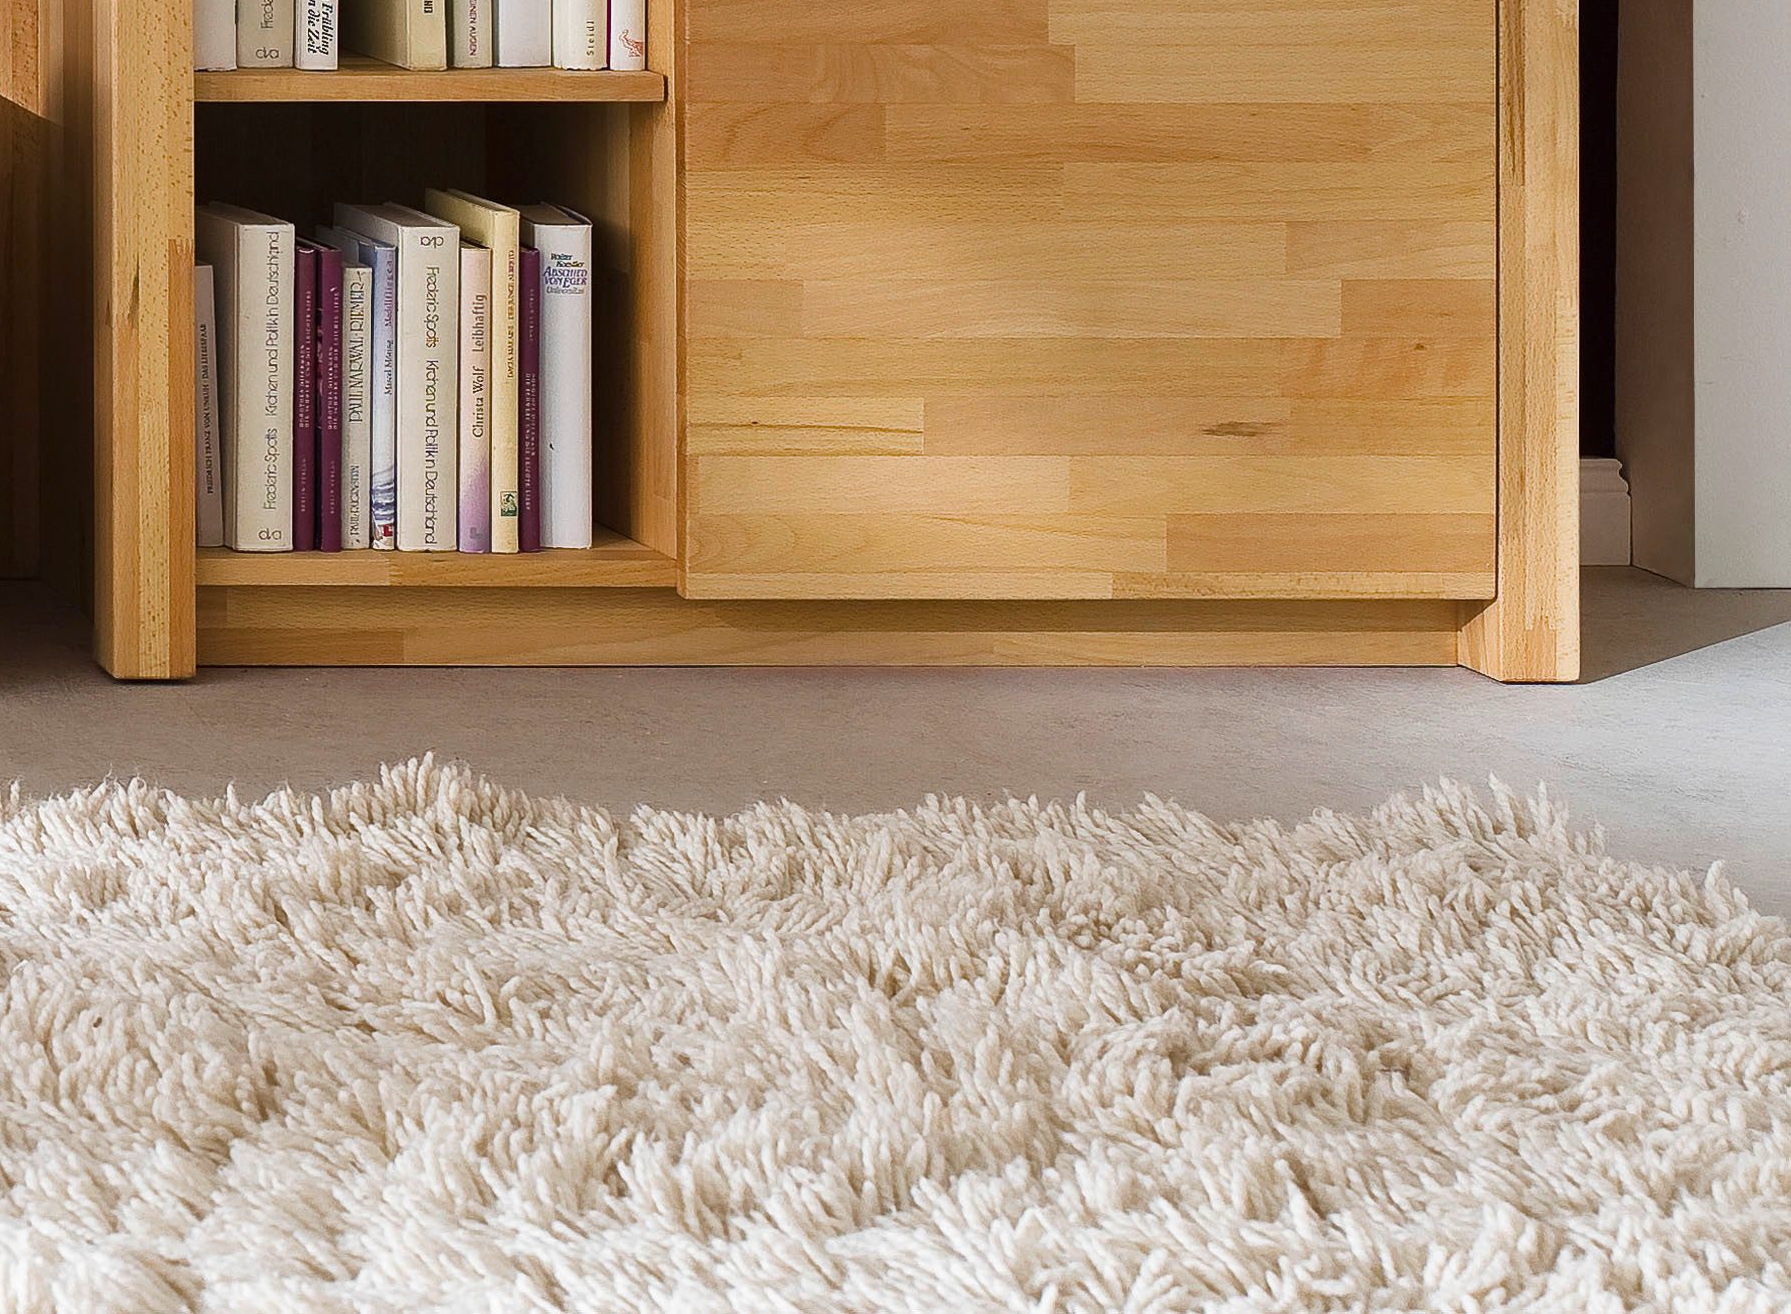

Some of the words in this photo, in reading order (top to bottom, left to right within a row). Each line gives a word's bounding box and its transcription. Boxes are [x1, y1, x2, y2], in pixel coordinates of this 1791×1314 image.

[306, 9, 320, 27] die
[318, 3, 334, 56] Frühling
[306, 28, 320, 54] Zeit
[586, 19, 595, 56] Steidl
[266, 232, 280, 306] Deutschland
[426, 266, 440, 313] Frederic
[426, 314, 440, 349] Spotts
[471, 294, 487, 353] Leibhaftig
[264, 349, 279, 373] und
[472, 365, 485, 392] Wolf
[348, 391, 364, 422] PAUL
[425, 403, 439, 427] und
[472, 397, 484, 438] Christa
[263, 428, 277, 463] Spotts
[262, 463, 277, 510] Frederic
[425, 471, 439, 544] Deutschland
